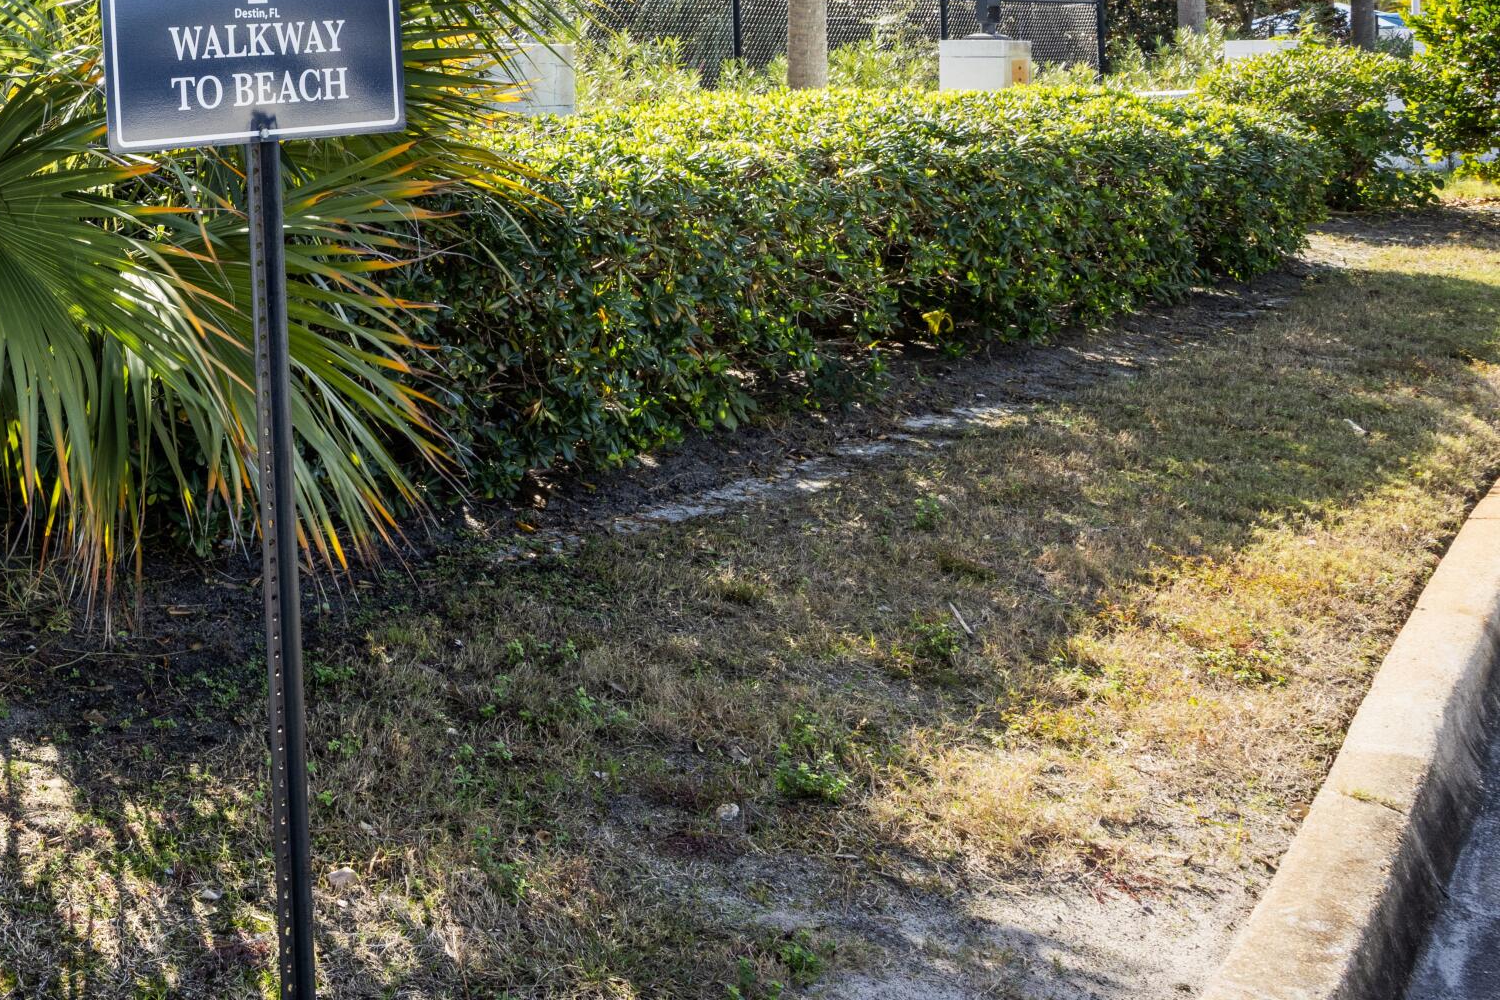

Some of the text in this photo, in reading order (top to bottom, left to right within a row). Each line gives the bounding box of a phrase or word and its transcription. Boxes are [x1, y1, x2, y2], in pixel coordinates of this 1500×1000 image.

[234, 7, 280, 19] Destin, FL
[168, 19, 346, 61] WALKWAY
[171, 67, 349, 111] TO BEACH
